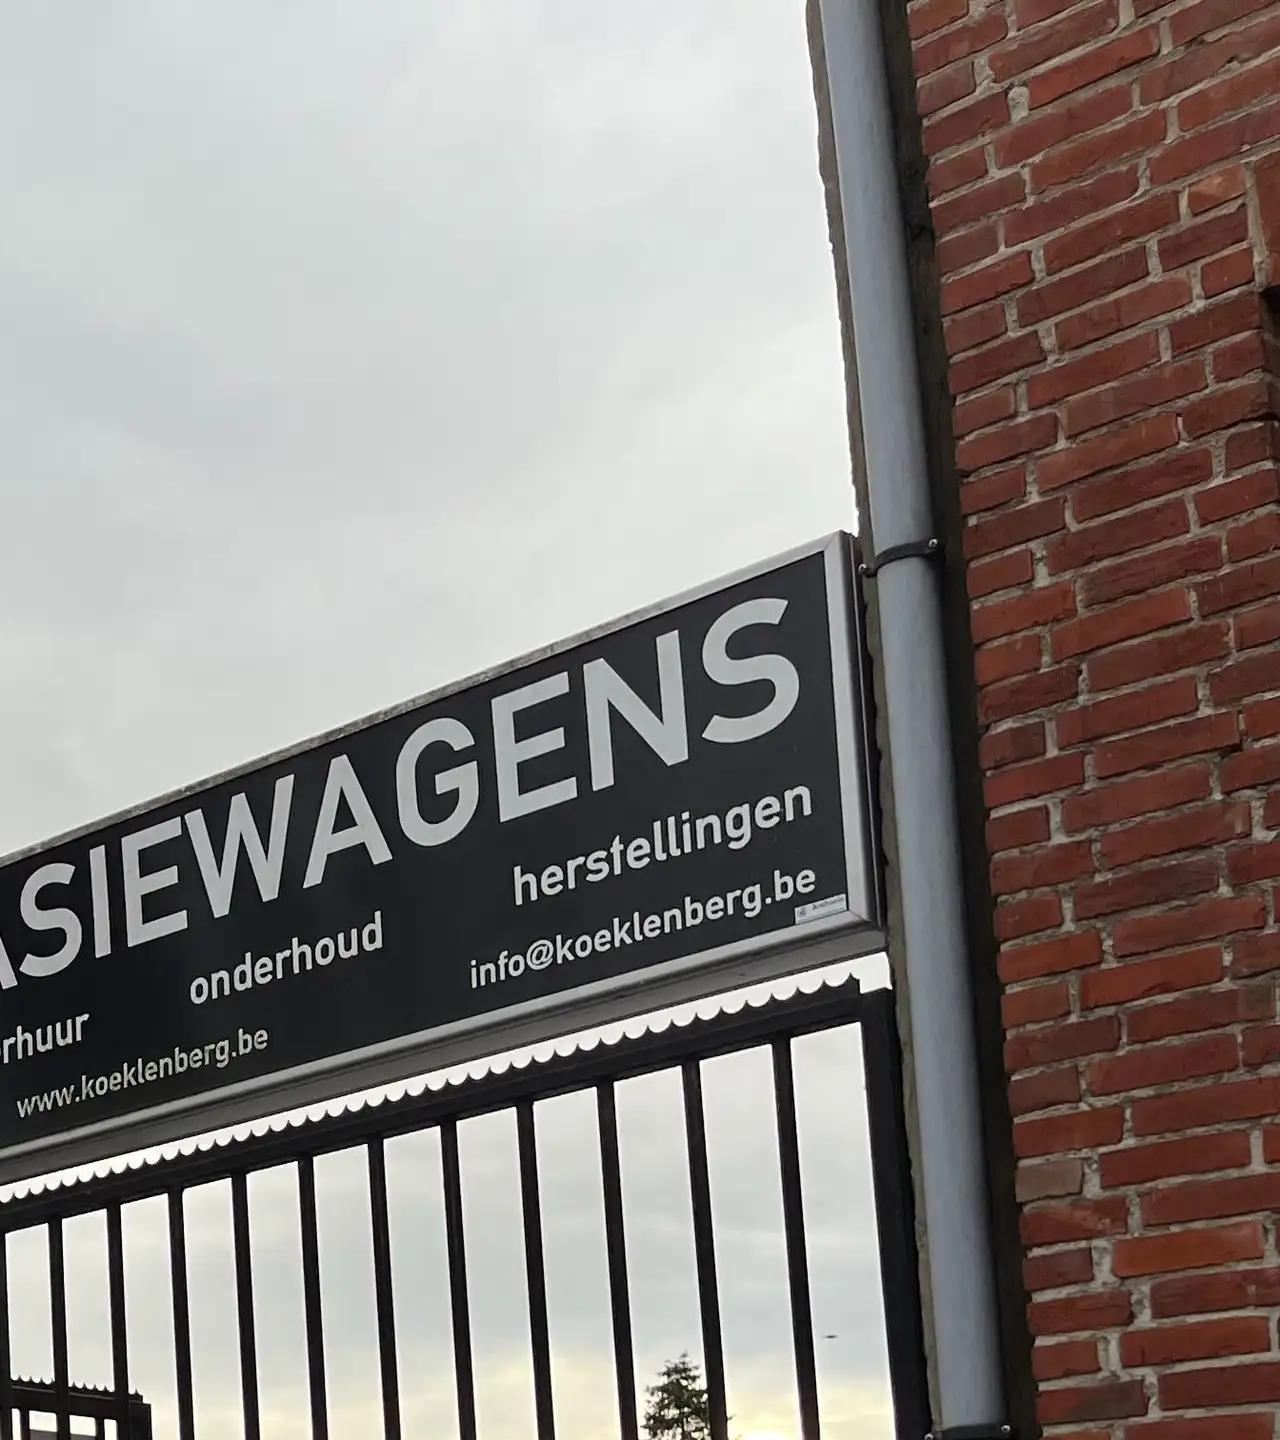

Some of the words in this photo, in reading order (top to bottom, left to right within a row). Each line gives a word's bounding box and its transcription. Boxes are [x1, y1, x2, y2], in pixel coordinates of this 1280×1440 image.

[513, 784, 812, 906] herstellingen
[189, 910, 383, 1005] onderhoud
[470, 866, 817, 989] info@koeklenberg.be
[16, 1027, 269, 1118] www.koeklenberg.be
